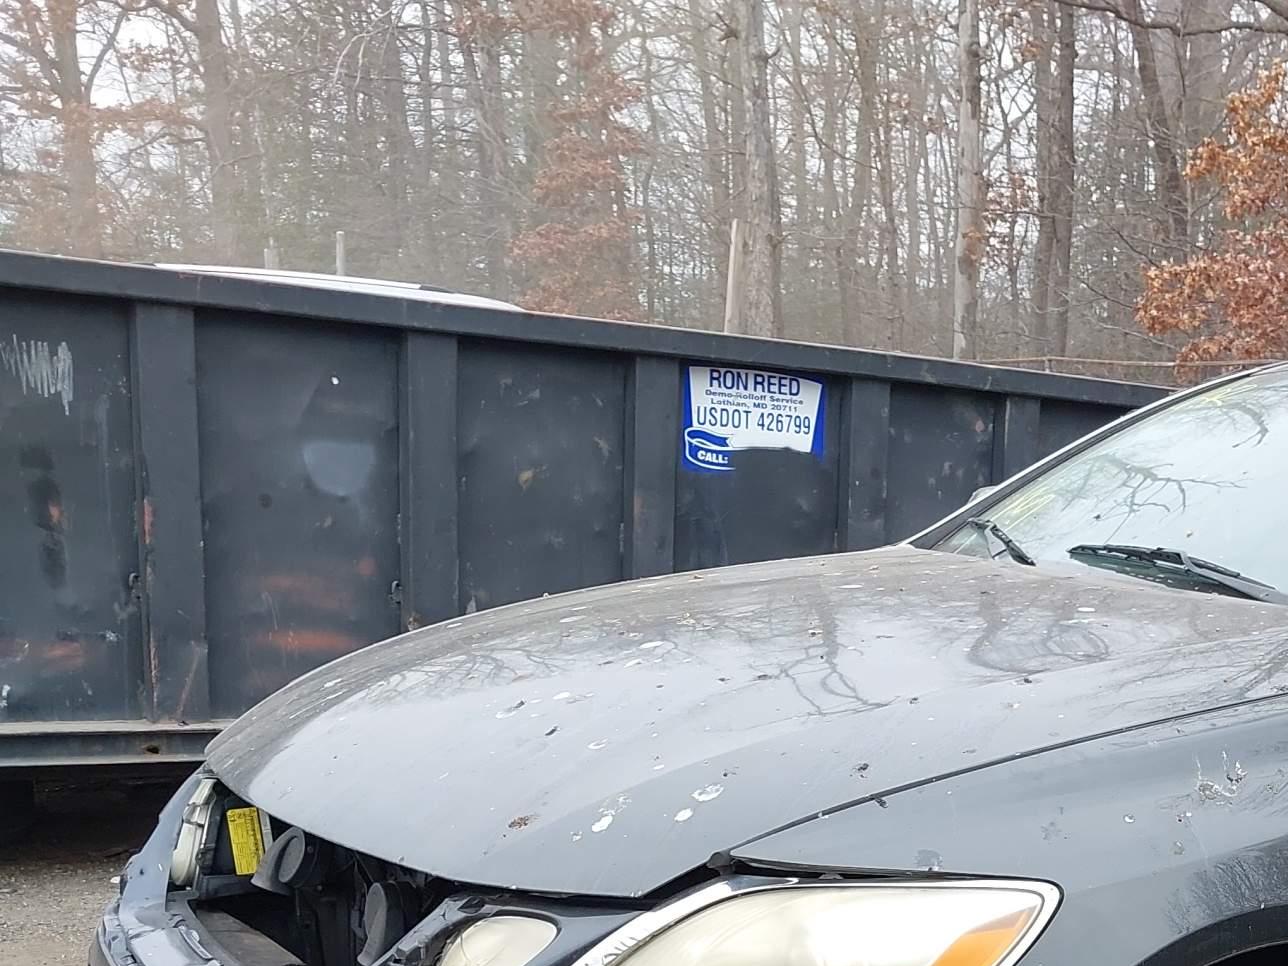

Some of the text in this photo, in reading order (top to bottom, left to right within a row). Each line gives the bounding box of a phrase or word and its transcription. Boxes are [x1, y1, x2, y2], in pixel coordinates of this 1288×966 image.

[709, 368, 801, 397] RON REED
[710, 398, 798, 413] Lothian, MD 20711
[769, 395, 804, 405] Service
[696, 406, 811, 435] USDOT 426799
[697, 450, 729, 464] CALL:
